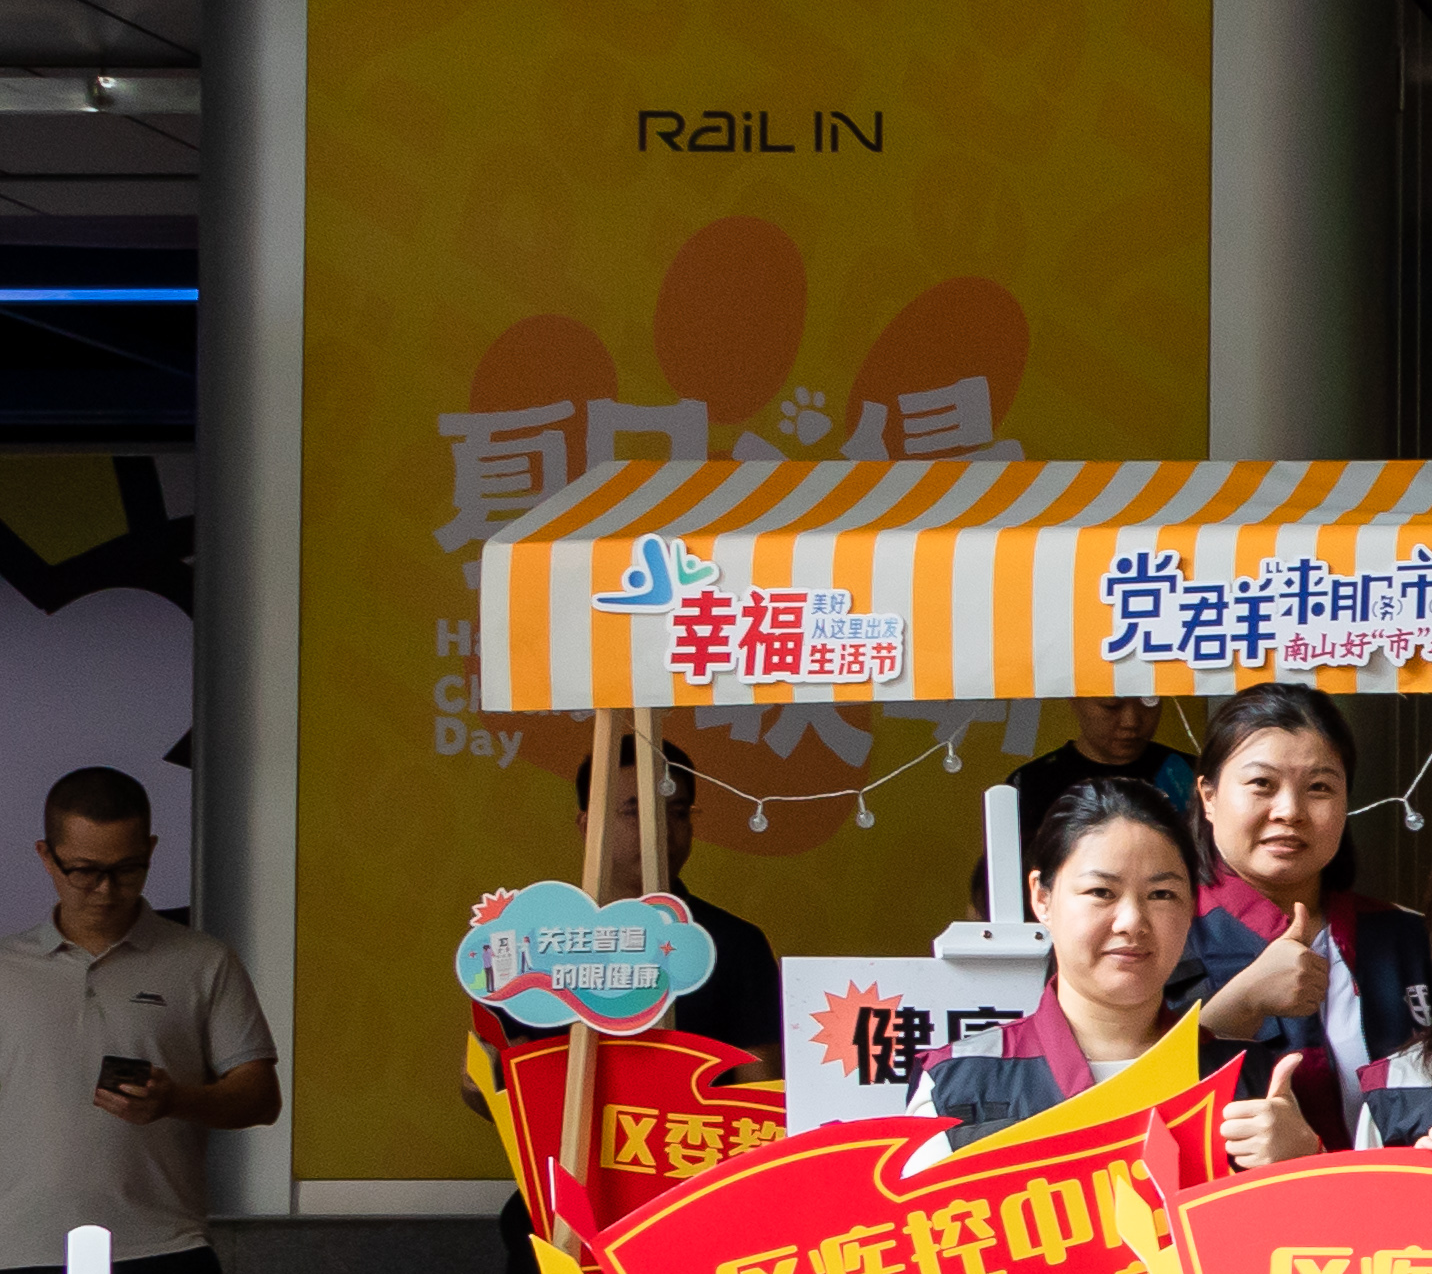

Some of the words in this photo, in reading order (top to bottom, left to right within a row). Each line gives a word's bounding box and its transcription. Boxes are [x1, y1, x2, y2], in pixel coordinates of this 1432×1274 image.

[811, 593, 847, 615] 美好
[670, 590, 809, 677] 幸福
[811, 617, 899, 640] 从这里出发
[807, 642, 898, 676] 生活节
[434, 715, 523, 769] Day
[538, 926, 646, 955] 关注普遍
[552, 963, 661, 990] 的眼健康
